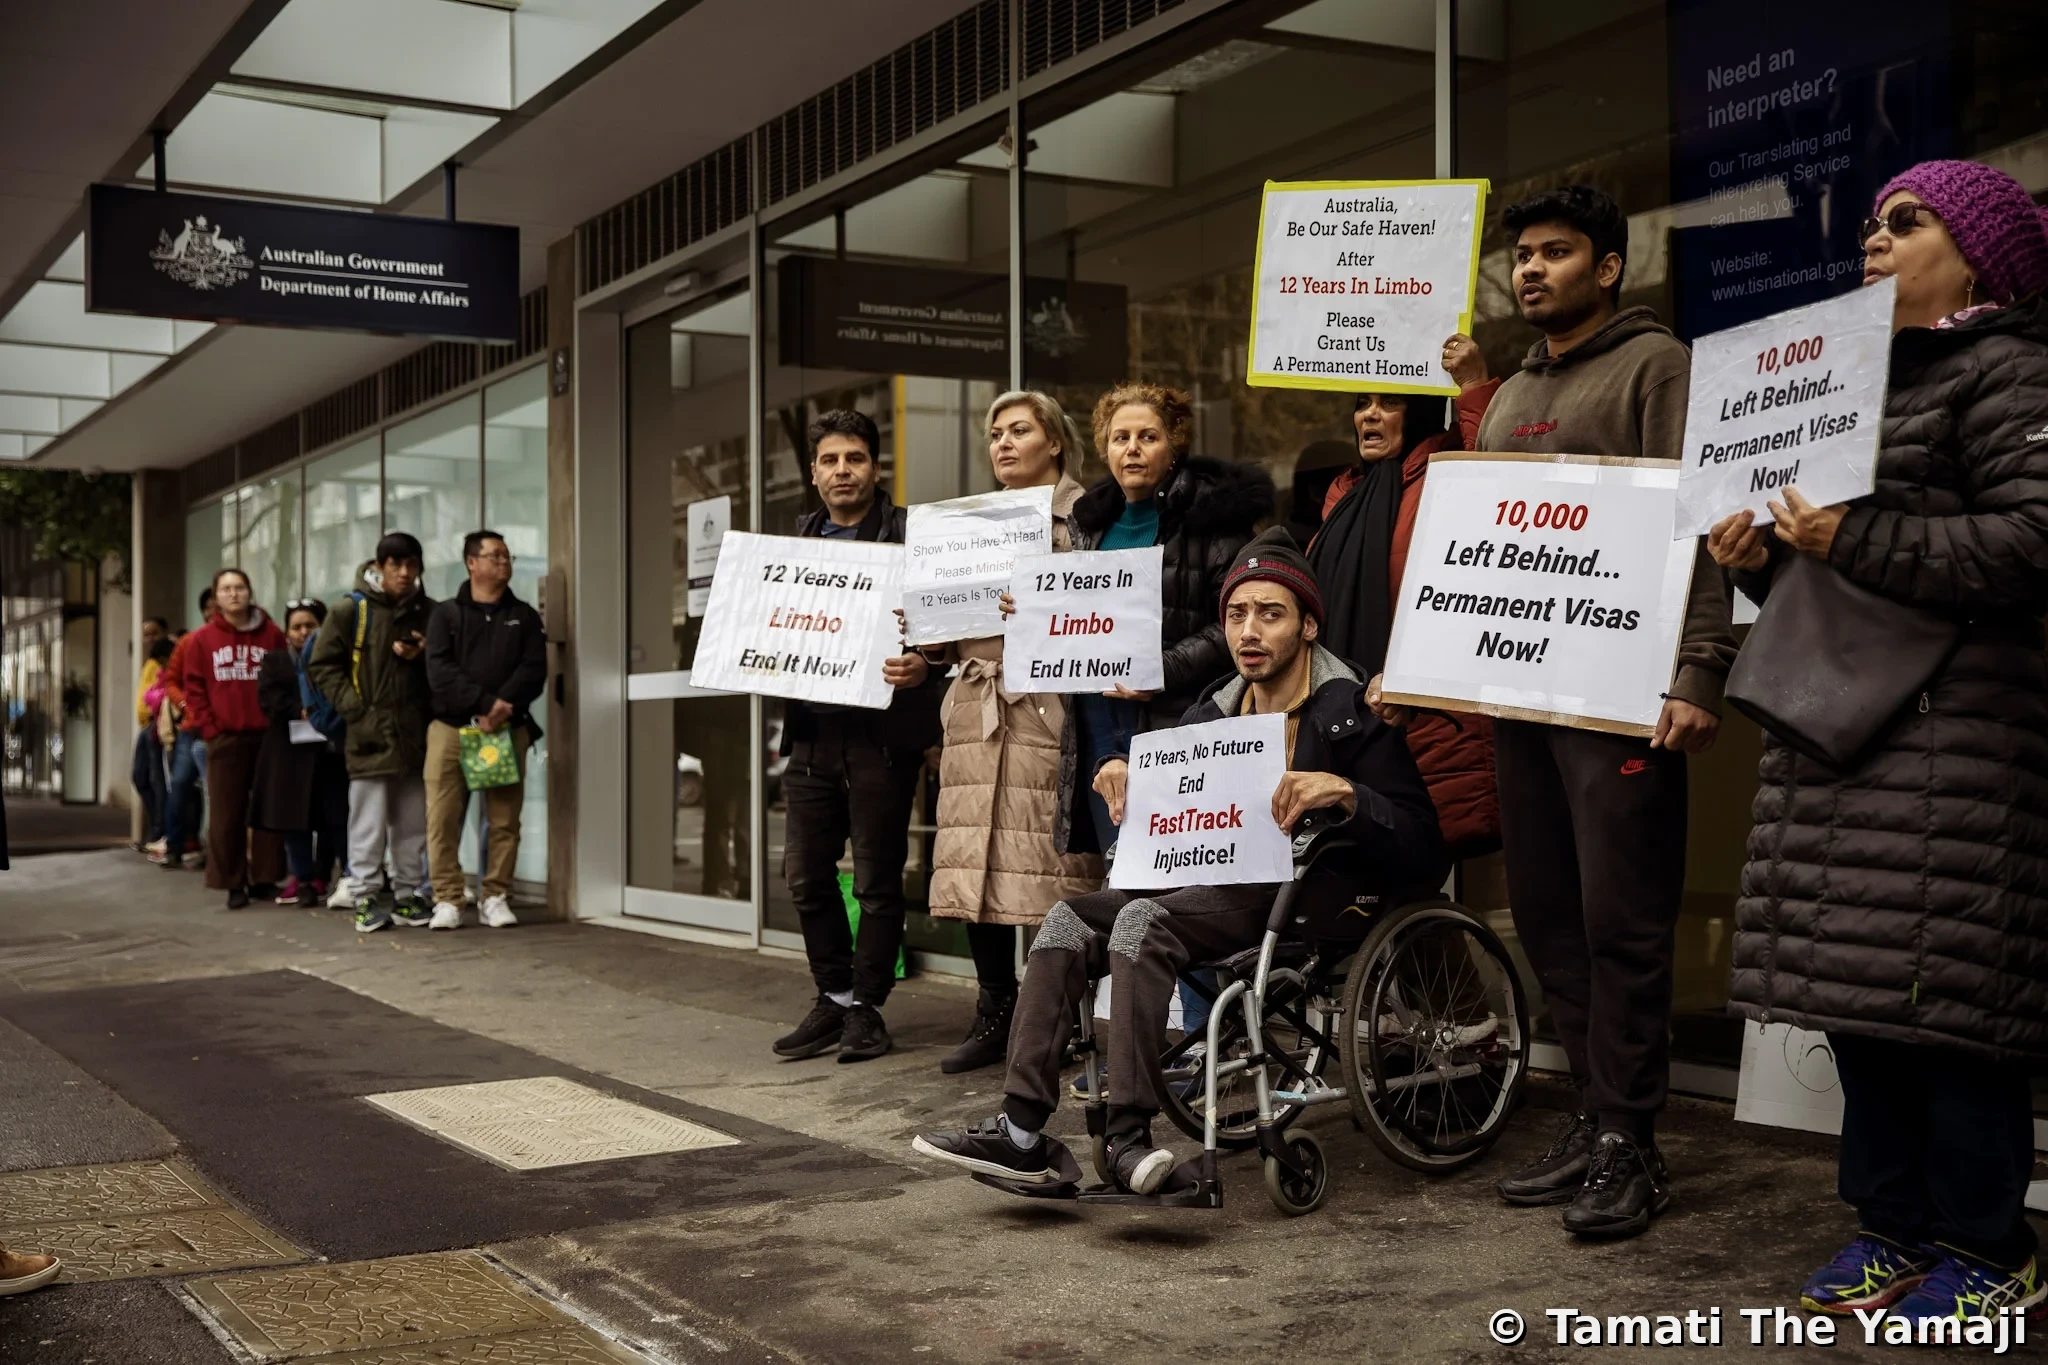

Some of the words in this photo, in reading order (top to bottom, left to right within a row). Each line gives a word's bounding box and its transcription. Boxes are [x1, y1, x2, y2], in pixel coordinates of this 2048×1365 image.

[1708, 53, 1760, 92] Need
[1769, 49, 1794, 72] an
[1708, 67, 1837, 128] interpreter?
[1709, 160, 1734, 177] Our
[1739, 137, 1819, 170] Translating
[1823, 124, 1851, 146] and
[1709, 170, 1790, 205] Interpreting
[1794, 155, 1850, 180] Service
[1324, 197, 1398, 215] Australia,
[1711, 212, 1734, 228] can
[1739, 201, 1769, 221] help
[1774, 195, 1804, 217] you.
[1287, 222, 1305, 237] Be
[1310, 222, 1338, 237] Our
[1342, 221, 1374, 236] Safe
[1378, 220, 1436, 236] Haven!
[260, 246, 345, 267] Australian
[348, 253, 444, 277] Government
[1337, 252, 1375, 267] After
[1711, 252, 1771, 279] Website:
[261, 276, 350, 297] Department
[354, 285, 370, 299] of
[374, 286, 416, 303] Home
[419, 291, 468, 307] Affairs
[1280, 277, 1297, 294] 12
[1302, 277, 1346, 295] Years
[1351, 277, 1369, 295] In
[1374, 277, 1433, 296] Limbo
[1327, 312, 1375, 329] Please
[1318, 335, 1361, 351] Grant
[1366, 336, 1386, 352] Us
[1757, 336, 1824, 376] 10,000
[1273, 356, 1284, 371] A
[1288, 357, 1371, 375] Permanent
[1376, 360, 1429, 377] Home!
[1720, 391, 1758, 422] Left
[1758, 368, 1845, 412] Behind...
[1699, 425, 1803, 467] Permanent
[1809, 408, 1858, 441] Visas
[1750, 460, 1800, 492] Now!
[1496, 501, 1589, 534] 10,000
[913, 544, 943, 557] Show
[947, 540, 967, 552] You
[971, 538, 1001, 549] Have
[1003, 533, 1012, 545] A
[1014, 528, 1044, 544] Heart
[935, 567, 973, 579] Please
[1444, 540, 1495, 568] Left
[1498, 543, 1620, 579] Behind...
[764, 565, 788, 583] 12
[794, 567, 849, 589] Years
[853, 573, 873, 591] In
[1036, 573, 1056, 592] 12
[1063, 572, 1112, 591] Years
[1117, 569, 1133, 588] In
[921, 595, 934, 608] 12
[937, 593, 968, 605] Years
[971, 590, 981, 601] Is
[984, 587, 1003, 599] Too
[1416, 586, 1557, 623] Permanent
[1566, 598, 1641, 631] Visas
[769, 607, 843, 634] Limbo
[1049, 612, 1114, 636] Limbo
[1476, 631, 1550, 664] Now!
[739, 649, 781, 671] End
[783, 654, 801, 673] It
[802, 656, 857, 678] Now!
[1030, 659, 1065, 679] End
[1069, 660, 1082, 678] It
[1087, 658, 1132, 678] Now!
[1140, 753, 1152, 769] 12
[1156, 750, 1189, 767] Years,
[1193, 744, 1209, 761] No
[1213, 740, 1264, 758] Future
[1179, 773, 1205, 795] End
[1150, 804, 1244, 837] FastTrack
[1154, 843, 1236, 874] Injustice!
